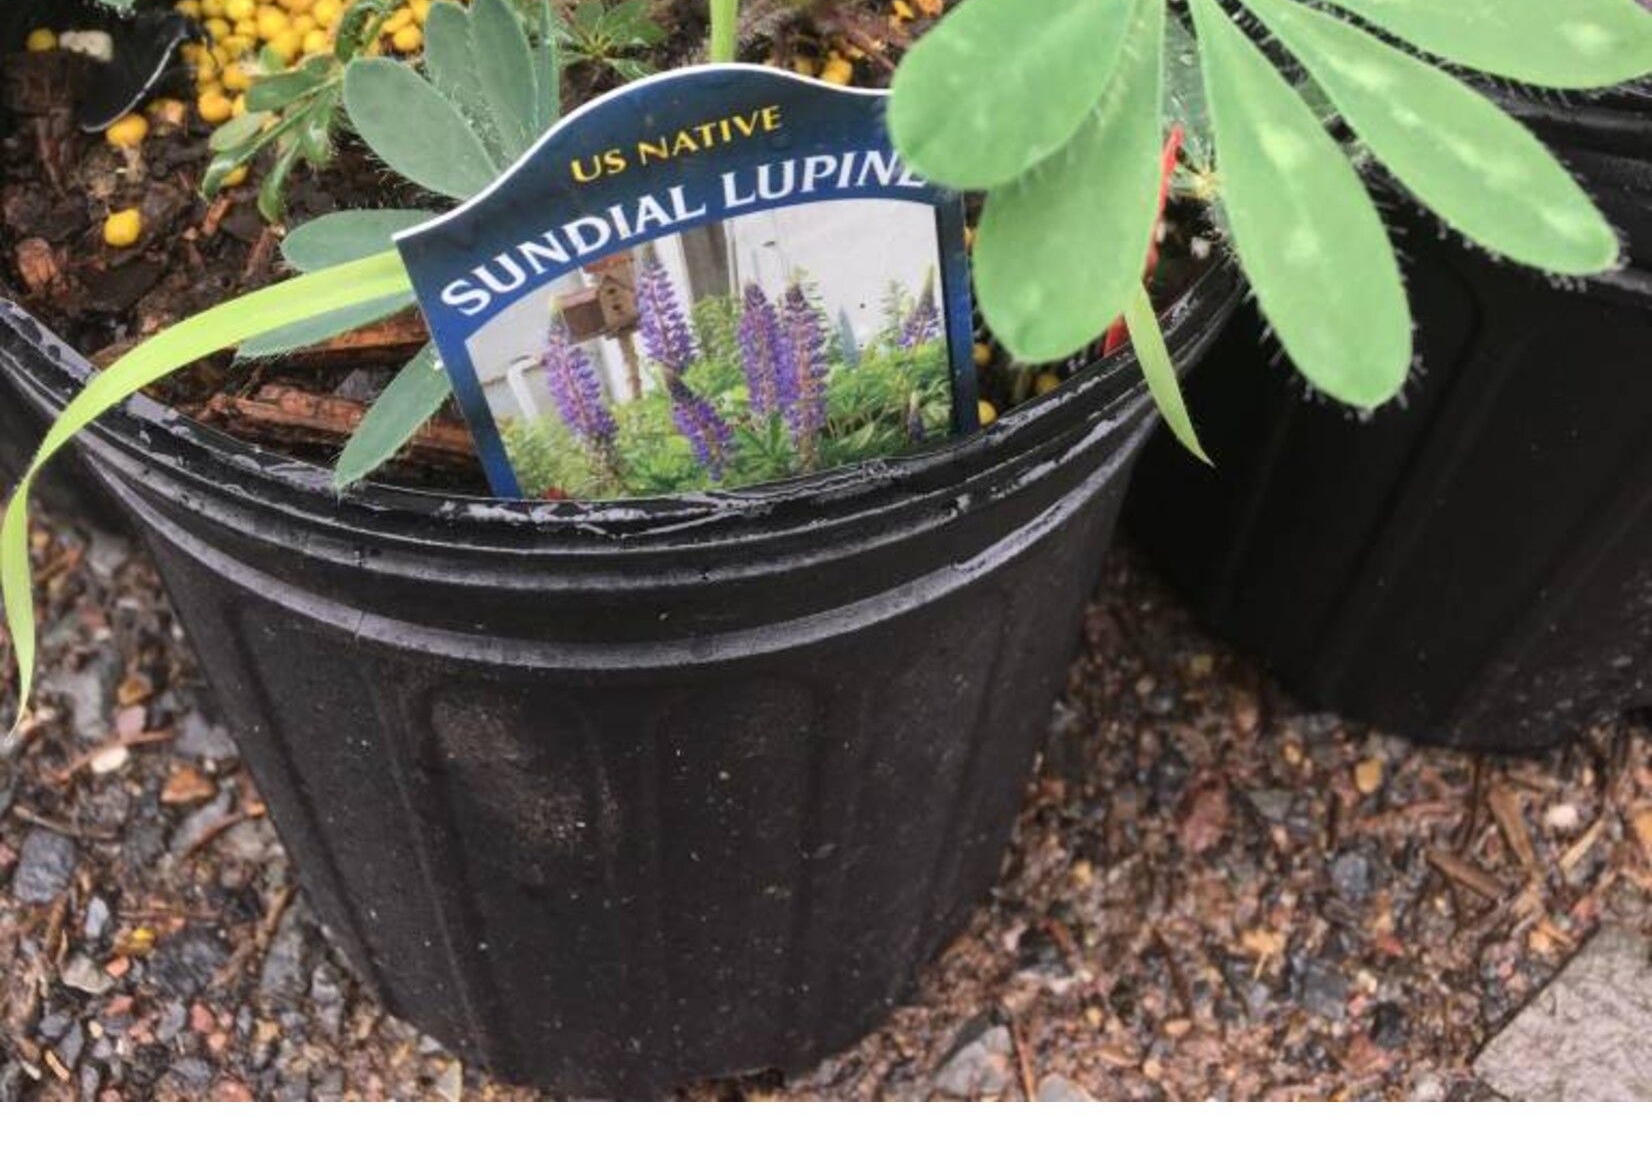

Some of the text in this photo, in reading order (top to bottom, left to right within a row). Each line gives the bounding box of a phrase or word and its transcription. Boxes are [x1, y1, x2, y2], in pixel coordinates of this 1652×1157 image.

[571, 104, 783, 184] US NATIVE
[440, 185, 706, 317] SUNDIAL
